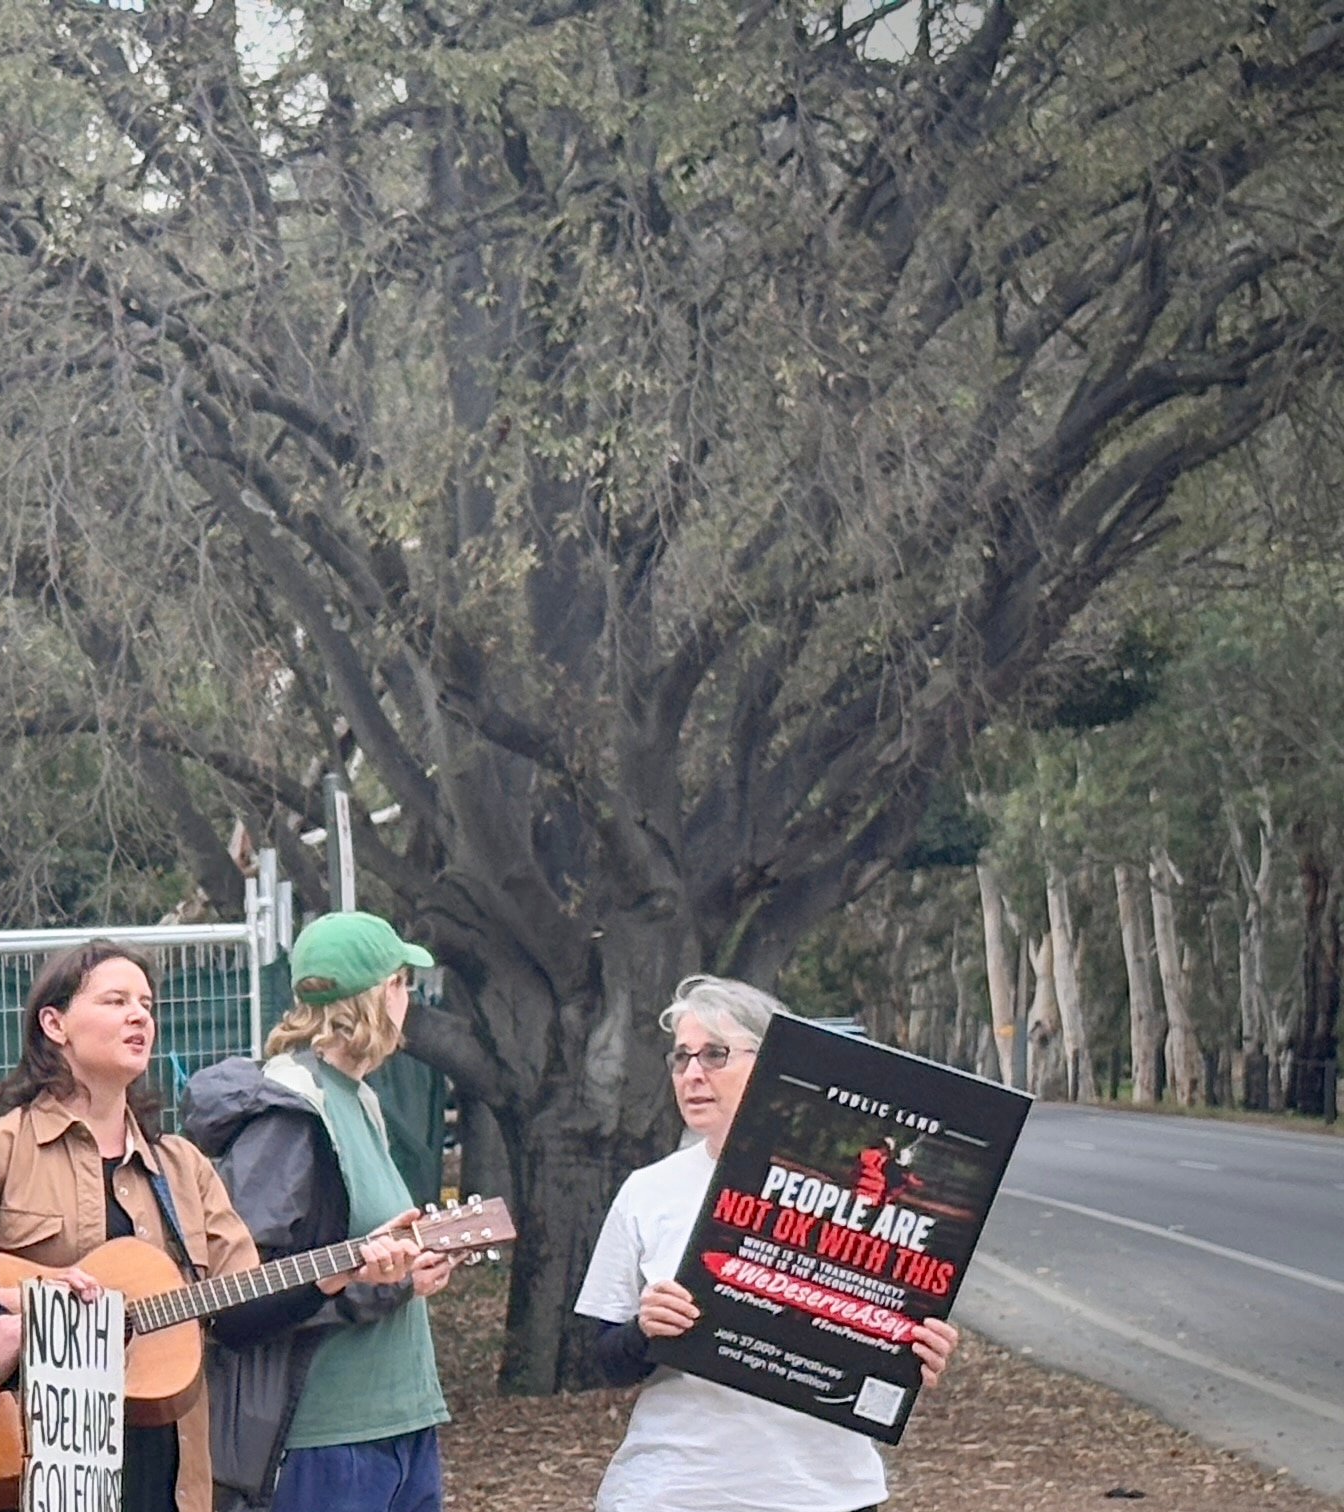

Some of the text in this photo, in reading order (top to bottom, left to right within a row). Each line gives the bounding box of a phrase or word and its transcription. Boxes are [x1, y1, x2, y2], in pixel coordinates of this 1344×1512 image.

[828, 1087, 939, 1133] PUBLIC LAND
[714, 1189, 953, 1293] NOT OK WITH THIS
[761, 1166, 935, 1252] PEOPLE ARE
[739, 1247, 774, 1266] WHERE
[776, 1260, 788, 1270] IS
[791, 1264, 810, 1278] THE
[744, 1237, 780, 1257] WHERE
[782, 1250, 793, 1261] IS
[797, 1255, 816, 1269] THE
[28, 1286, 110, 1369] NORTH
[721, 1259, 911, 1340] #WeDeserveASay
[31, 1380, 116, 1457] ADELAIDE
